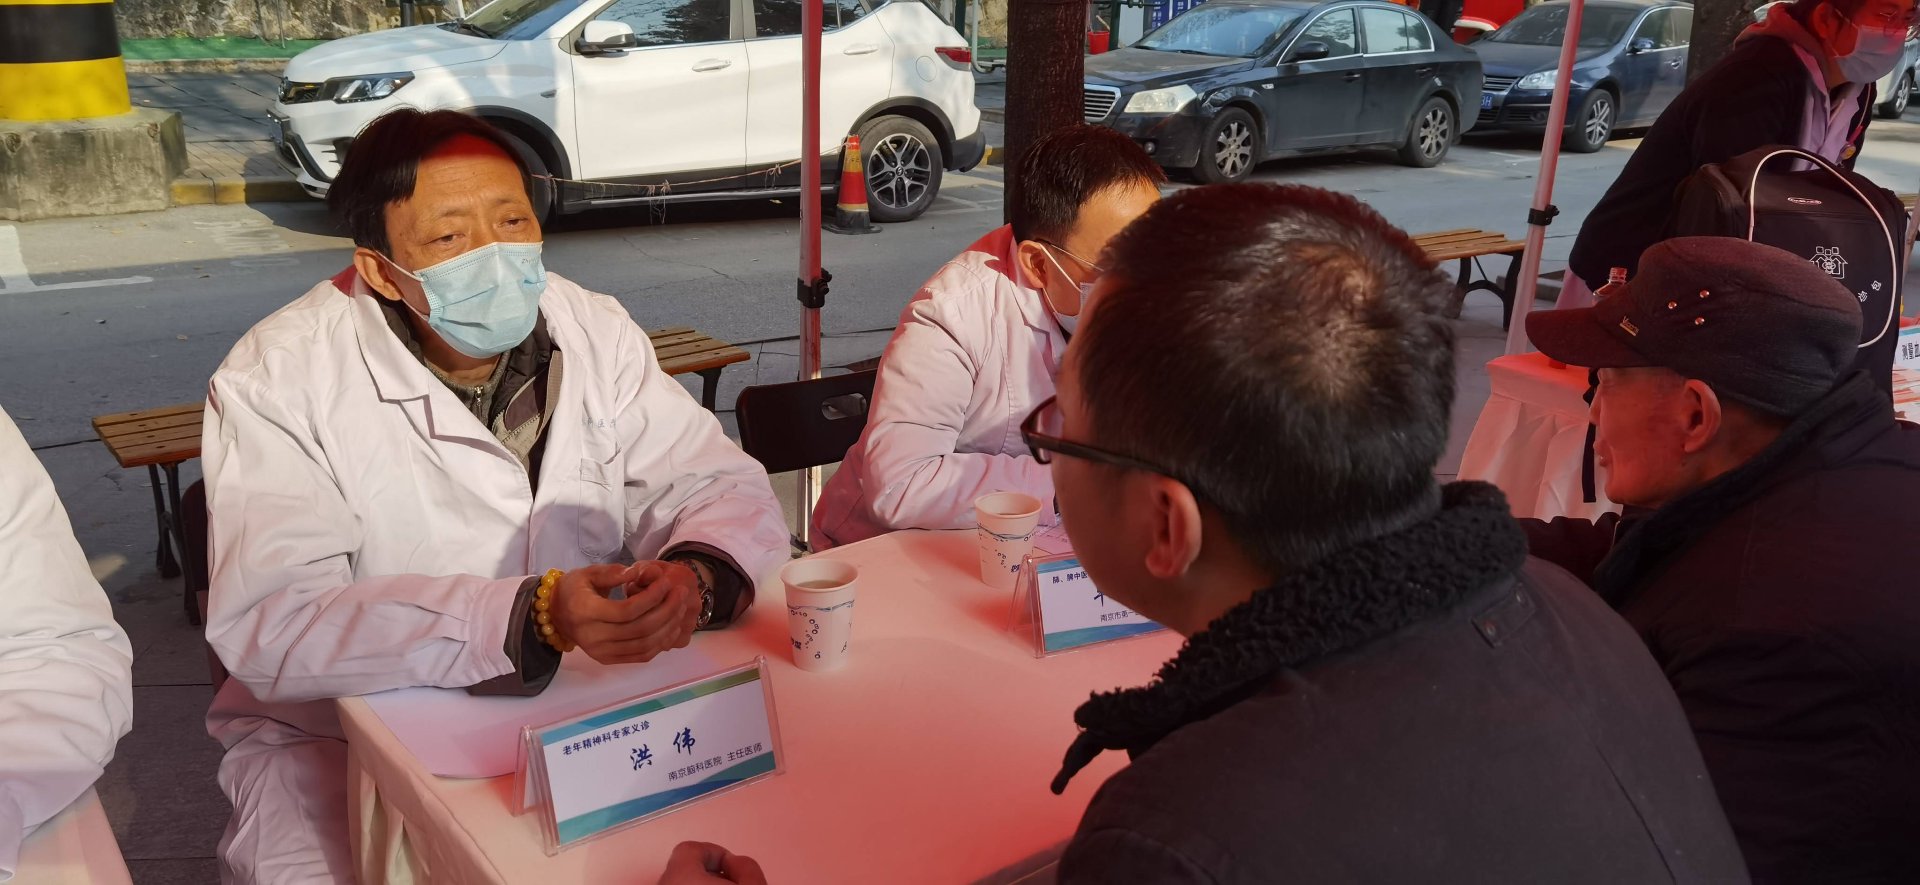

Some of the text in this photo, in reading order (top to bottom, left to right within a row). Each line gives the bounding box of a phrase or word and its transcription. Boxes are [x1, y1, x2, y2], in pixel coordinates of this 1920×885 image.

[1100, 610, 1141, 622] 南京市第一
[562, 720, 650, 755] 老年精神科专家义诊
[630, 727, 696, 771] 洪 伟
[668, 742, 763, 782] 南京脑科医院 主任医师
